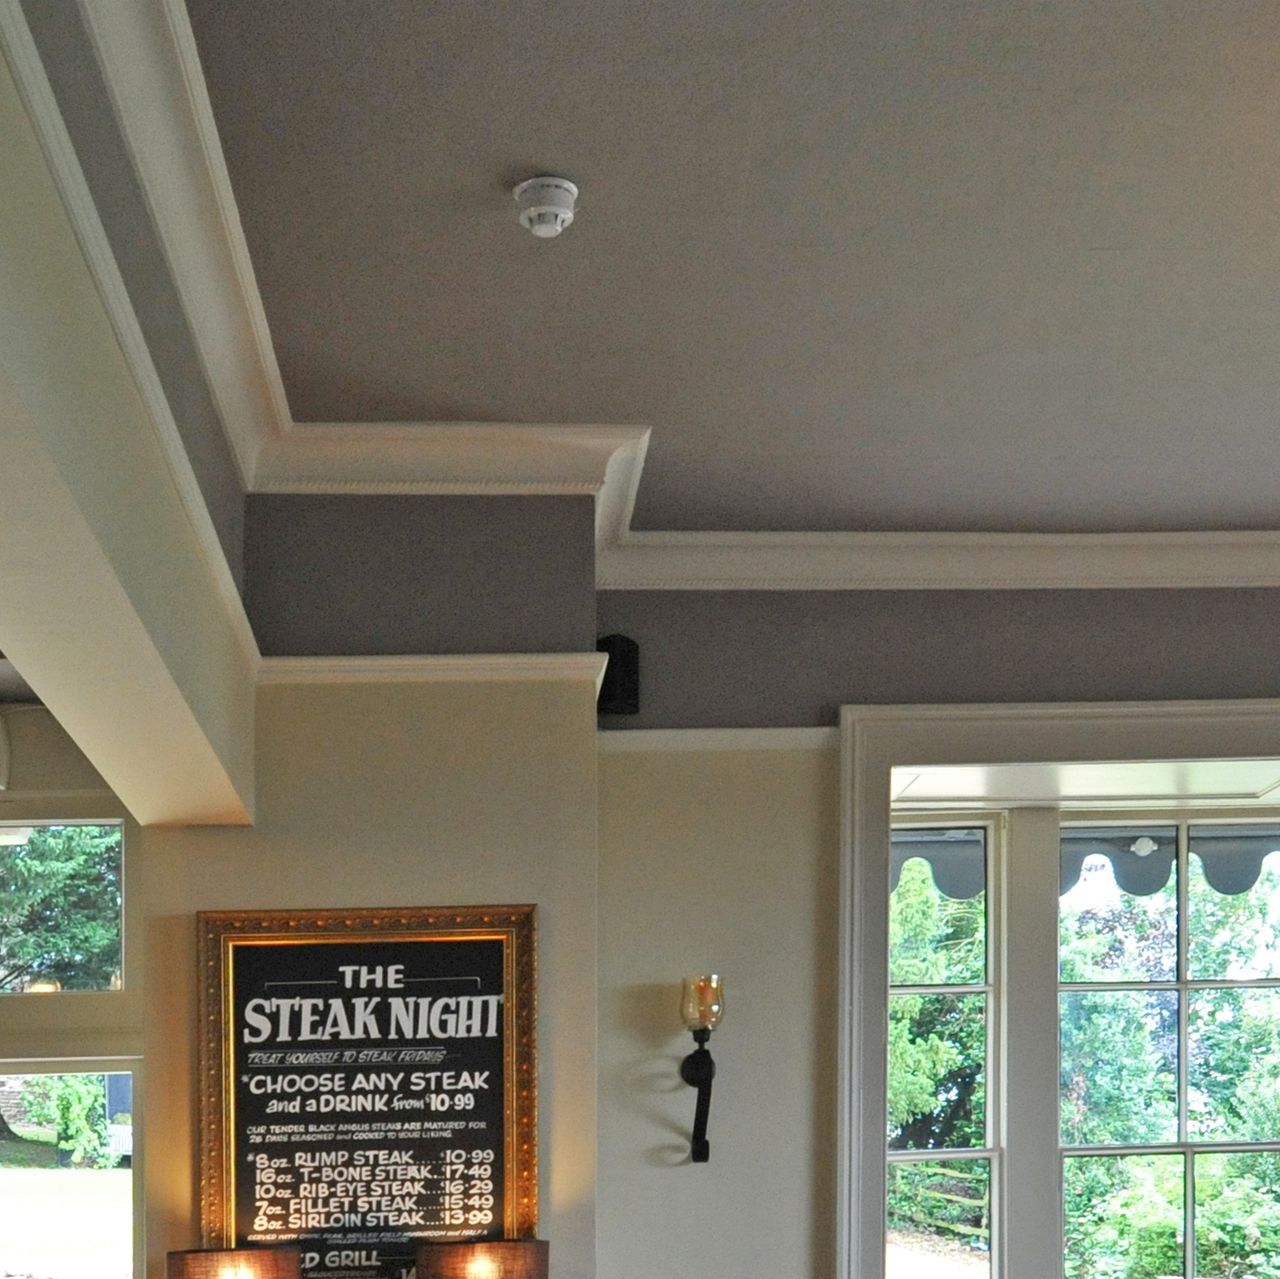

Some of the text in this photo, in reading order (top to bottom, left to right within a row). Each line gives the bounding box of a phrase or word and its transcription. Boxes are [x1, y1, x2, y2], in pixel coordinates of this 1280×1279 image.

[338, 964, 405, 989] THE
[243, 993, 504, 1044] STEAK NIGHT
[248, 1050, 447, 1064] TREAT YOURSELF TO STEAK FRIDAYS
[249, 1071, 490, 1095] CHOOSE ANY STEAK
[265, 1095, 301, 1114] and
[305, 1098, 317, 1112] a
[319, 1093, 389, 1113] DRINK
[391, 1094, 424, 1111] from
[246, 1121, 487, 1135] OUR TENDER BLACK ANGUS STEAKS ARE MATURED FOR
[290, 1133, 335, 1142] SEASONED
[352, 1132, 385, 1140] COOKED
[387, 1131, 397, 1139] TO
[398, 1131, 421, 1139] YOUR
[295, 1151, 349, 1168] RUMP
[299, 1166, 372, 1182] T-BONE
[299, 1182, 367, 1198] RIB-EYE
[289, 1197, 354, 1214] FILLET
[288, 1212, 362, 1229] SIRLOIN
[324, 1250, 381, 1267] GRILL
